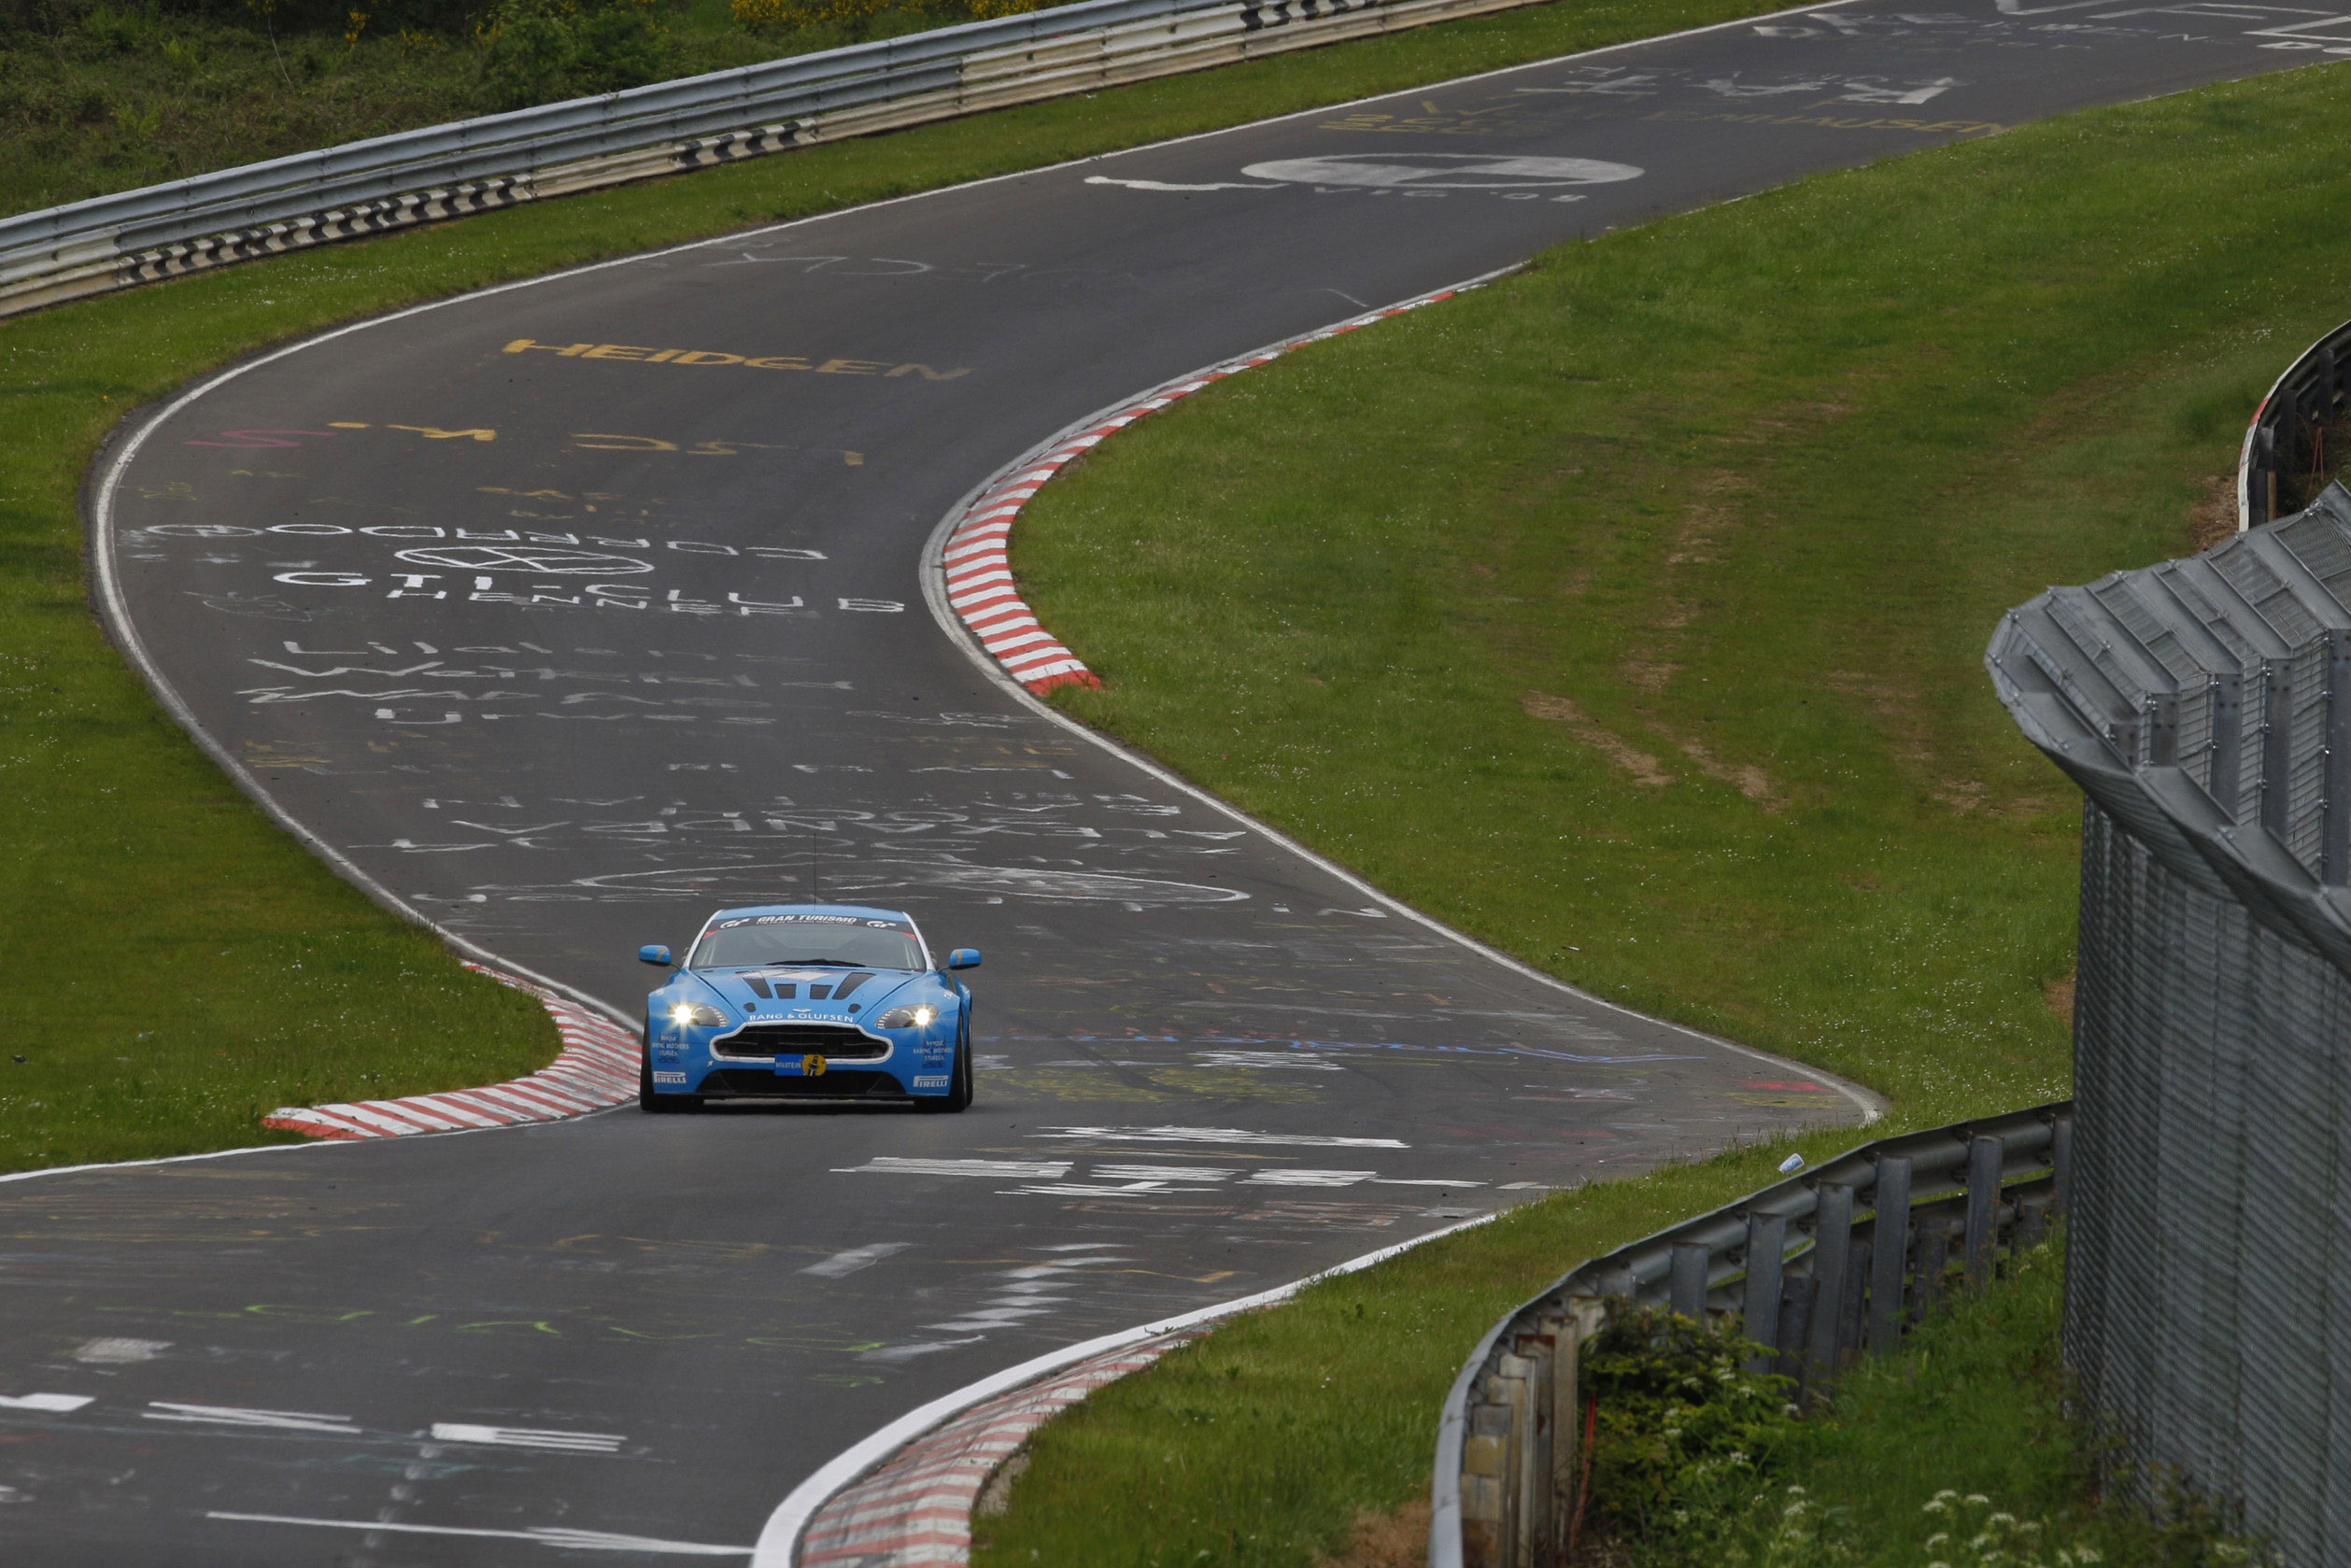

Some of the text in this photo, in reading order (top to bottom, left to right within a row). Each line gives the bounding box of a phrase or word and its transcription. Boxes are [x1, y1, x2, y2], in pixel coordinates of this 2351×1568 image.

[502, 339, 974, 380] HEIDGEN
[267, 523, 827, 560] CORRADO
[274, 572, 905, 612] GTI-CLUB
[387, 588, 792, 616] HENNEF
[450, 818, 1247, 841] ALEXANDRA
[799, 914, 857, 924] TURISMO
[749, 1013, 783, 1022] BANG
[798, 1013, 854, 1023] OLUFSEN
[653, 1071, 687, 1084] PIRELLI
[913, 1075, 949, 1088] PIRELLI
